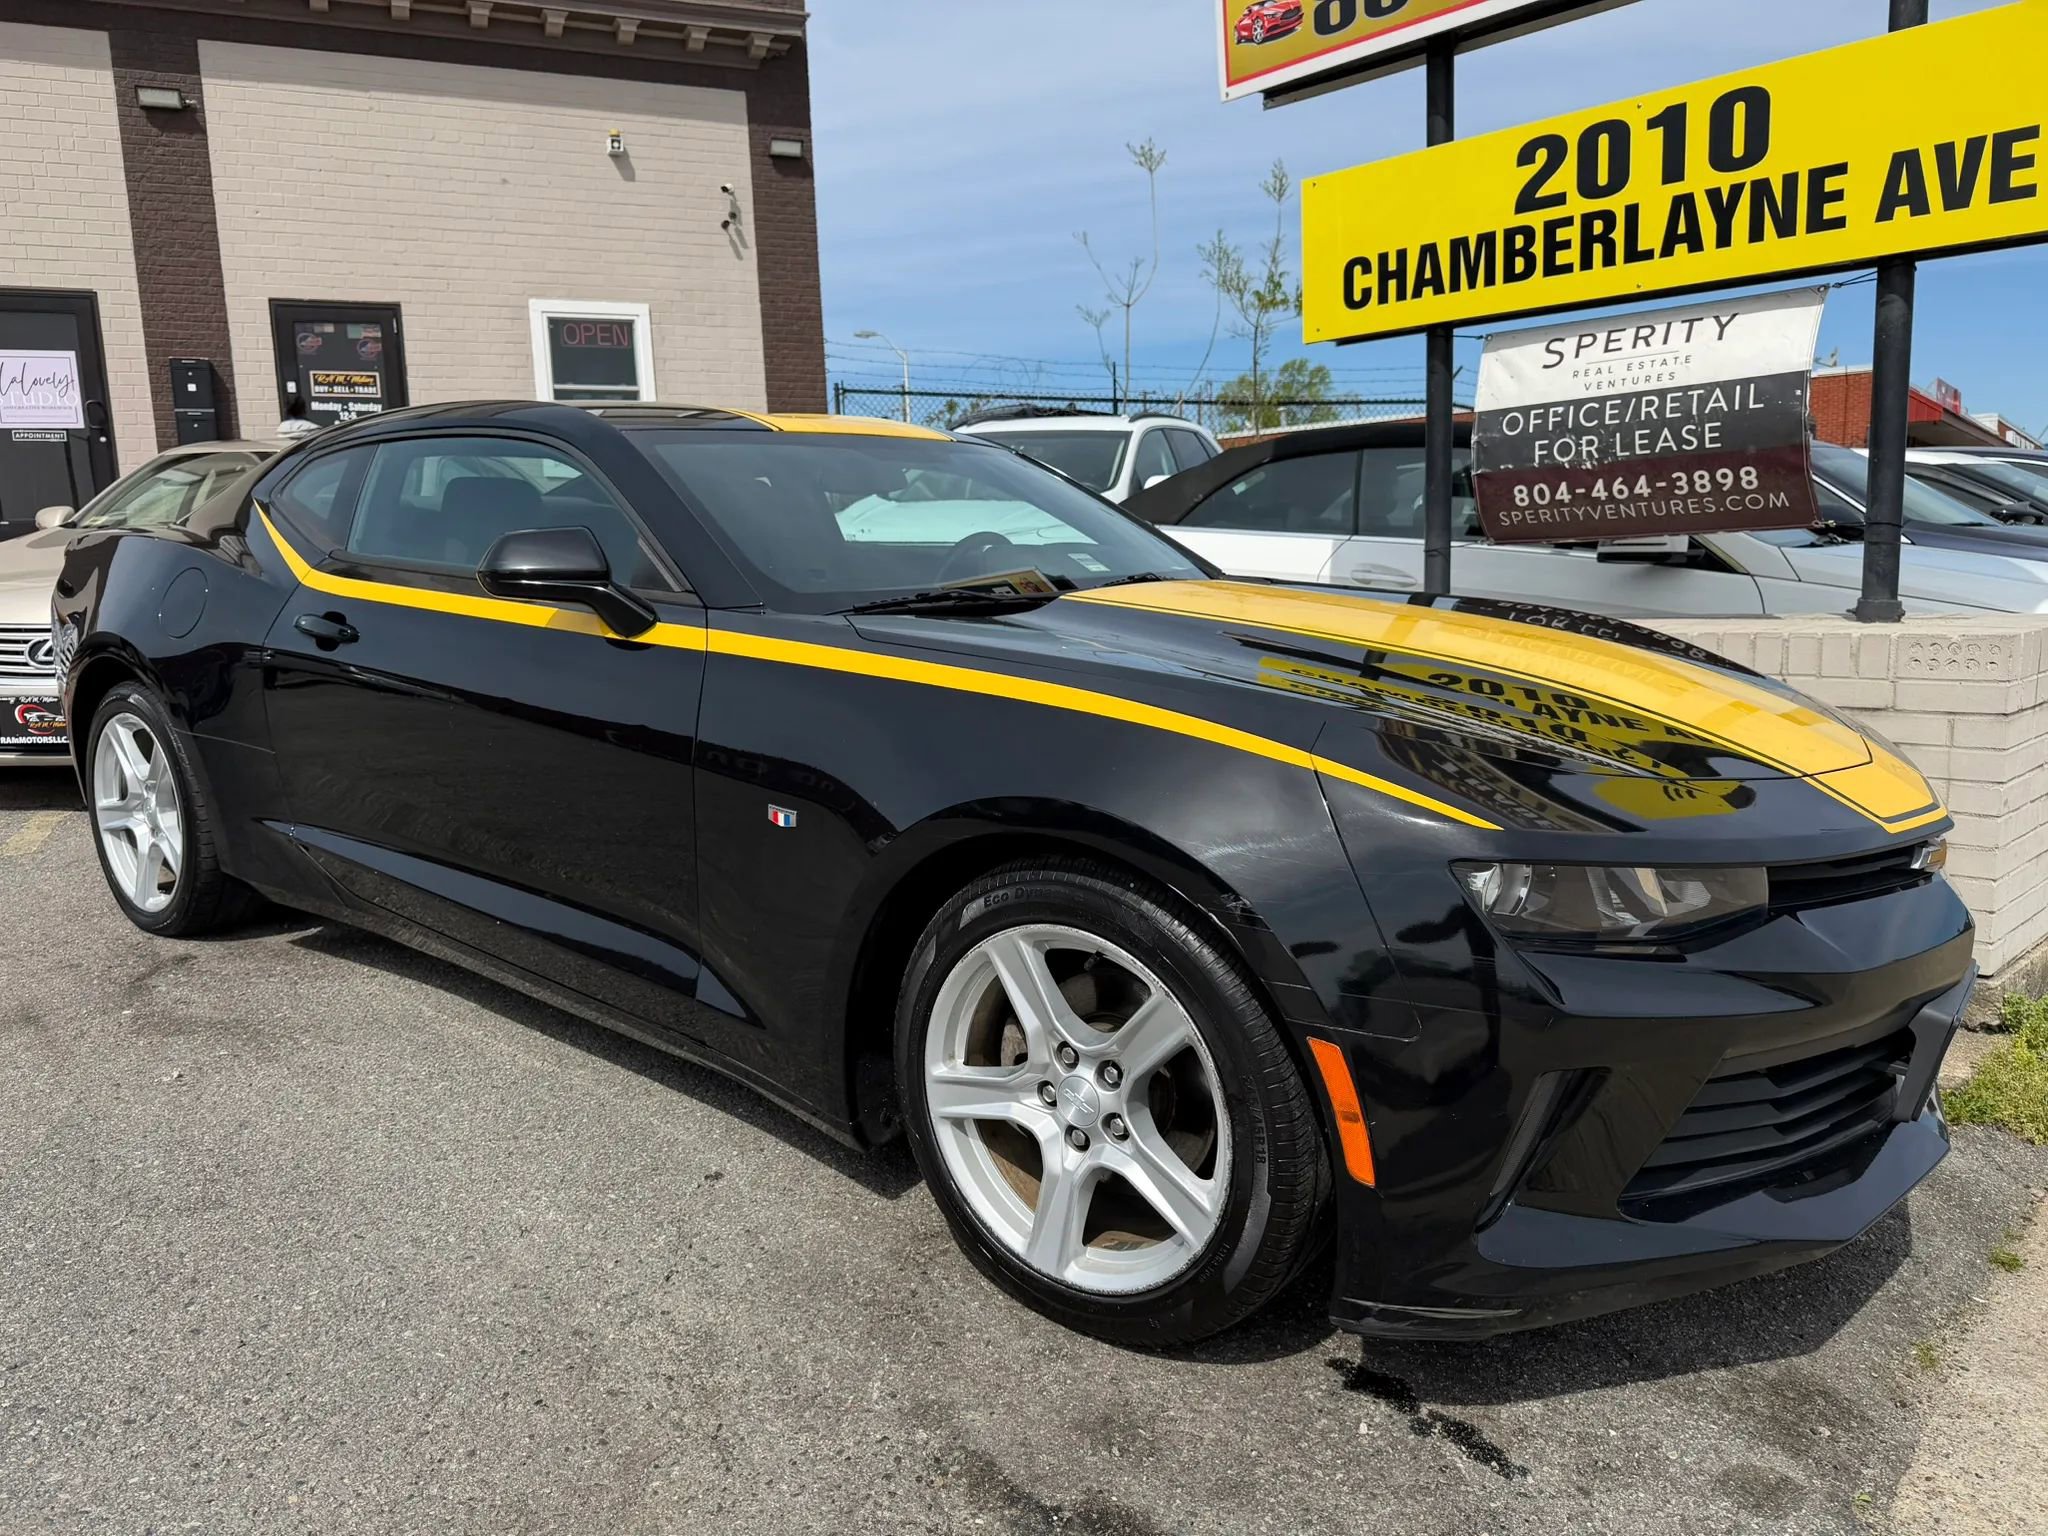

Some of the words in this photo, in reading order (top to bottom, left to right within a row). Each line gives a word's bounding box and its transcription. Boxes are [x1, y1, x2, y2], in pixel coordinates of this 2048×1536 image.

[1515, 85, 1771, 214] 2010
[1342, 161, 1848, 311] CHAMBERLAYNE
[1874, 124, 2041, 223] AVE
[563, 323, 629, 346] OPEN
[1541, 313, 1739, 369] SPERITY
[1572, 366, 1614, 379] REAL
[1626, 355, 1692, 371] ESTATE
[1584, 371, 1676, 391] VENTURES
[311, 401, 342, 412] Monday
[348, 402, 382, 413] Saturday
[314, 385, 328, 393] BUY
[333, 385, 350, 394] SELL
[354, 385, 377, 394] TRADE
[1502, 383, 1764, 436] OFFICE/RETAIL
[1534, 436, 1599, 465] FOR
[1615, 422, 1723, 457] LEASE
[1513, 466, 1760, 507] 804-464-3898
[1499, 491, 1790, 527] SPERITYVENTURES.COM
